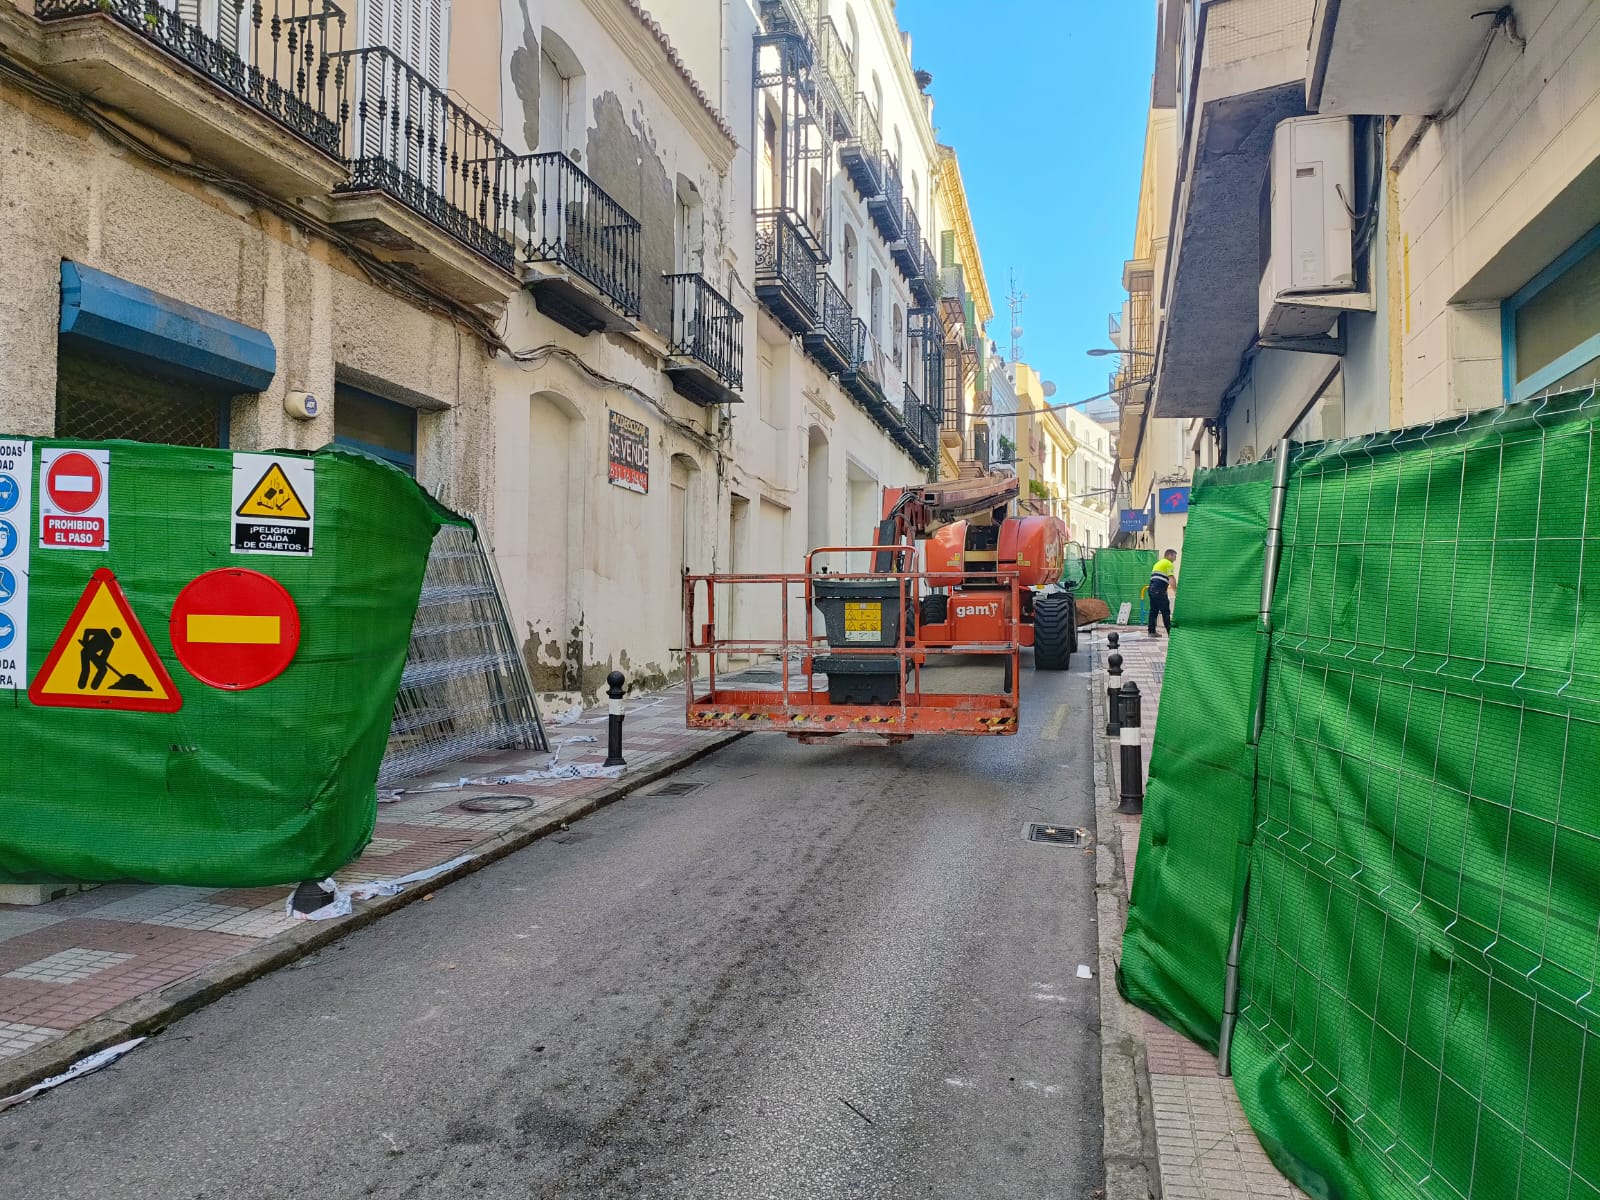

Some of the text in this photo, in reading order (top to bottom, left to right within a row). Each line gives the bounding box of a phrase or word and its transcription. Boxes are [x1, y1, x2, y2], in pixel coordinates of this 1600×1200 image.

[609, 433, 620, 458] SE
[621, 438, 648, 468] VENDE
[48, 519, 100, 531] PROHIBIDO
[250, 526, 297, 535] ¡PELIGRO!
[55, 532, 93, 544] EL PASO
[258, 542, 302, 551] OBJETOS
[0, 659, 16, 670] DA
